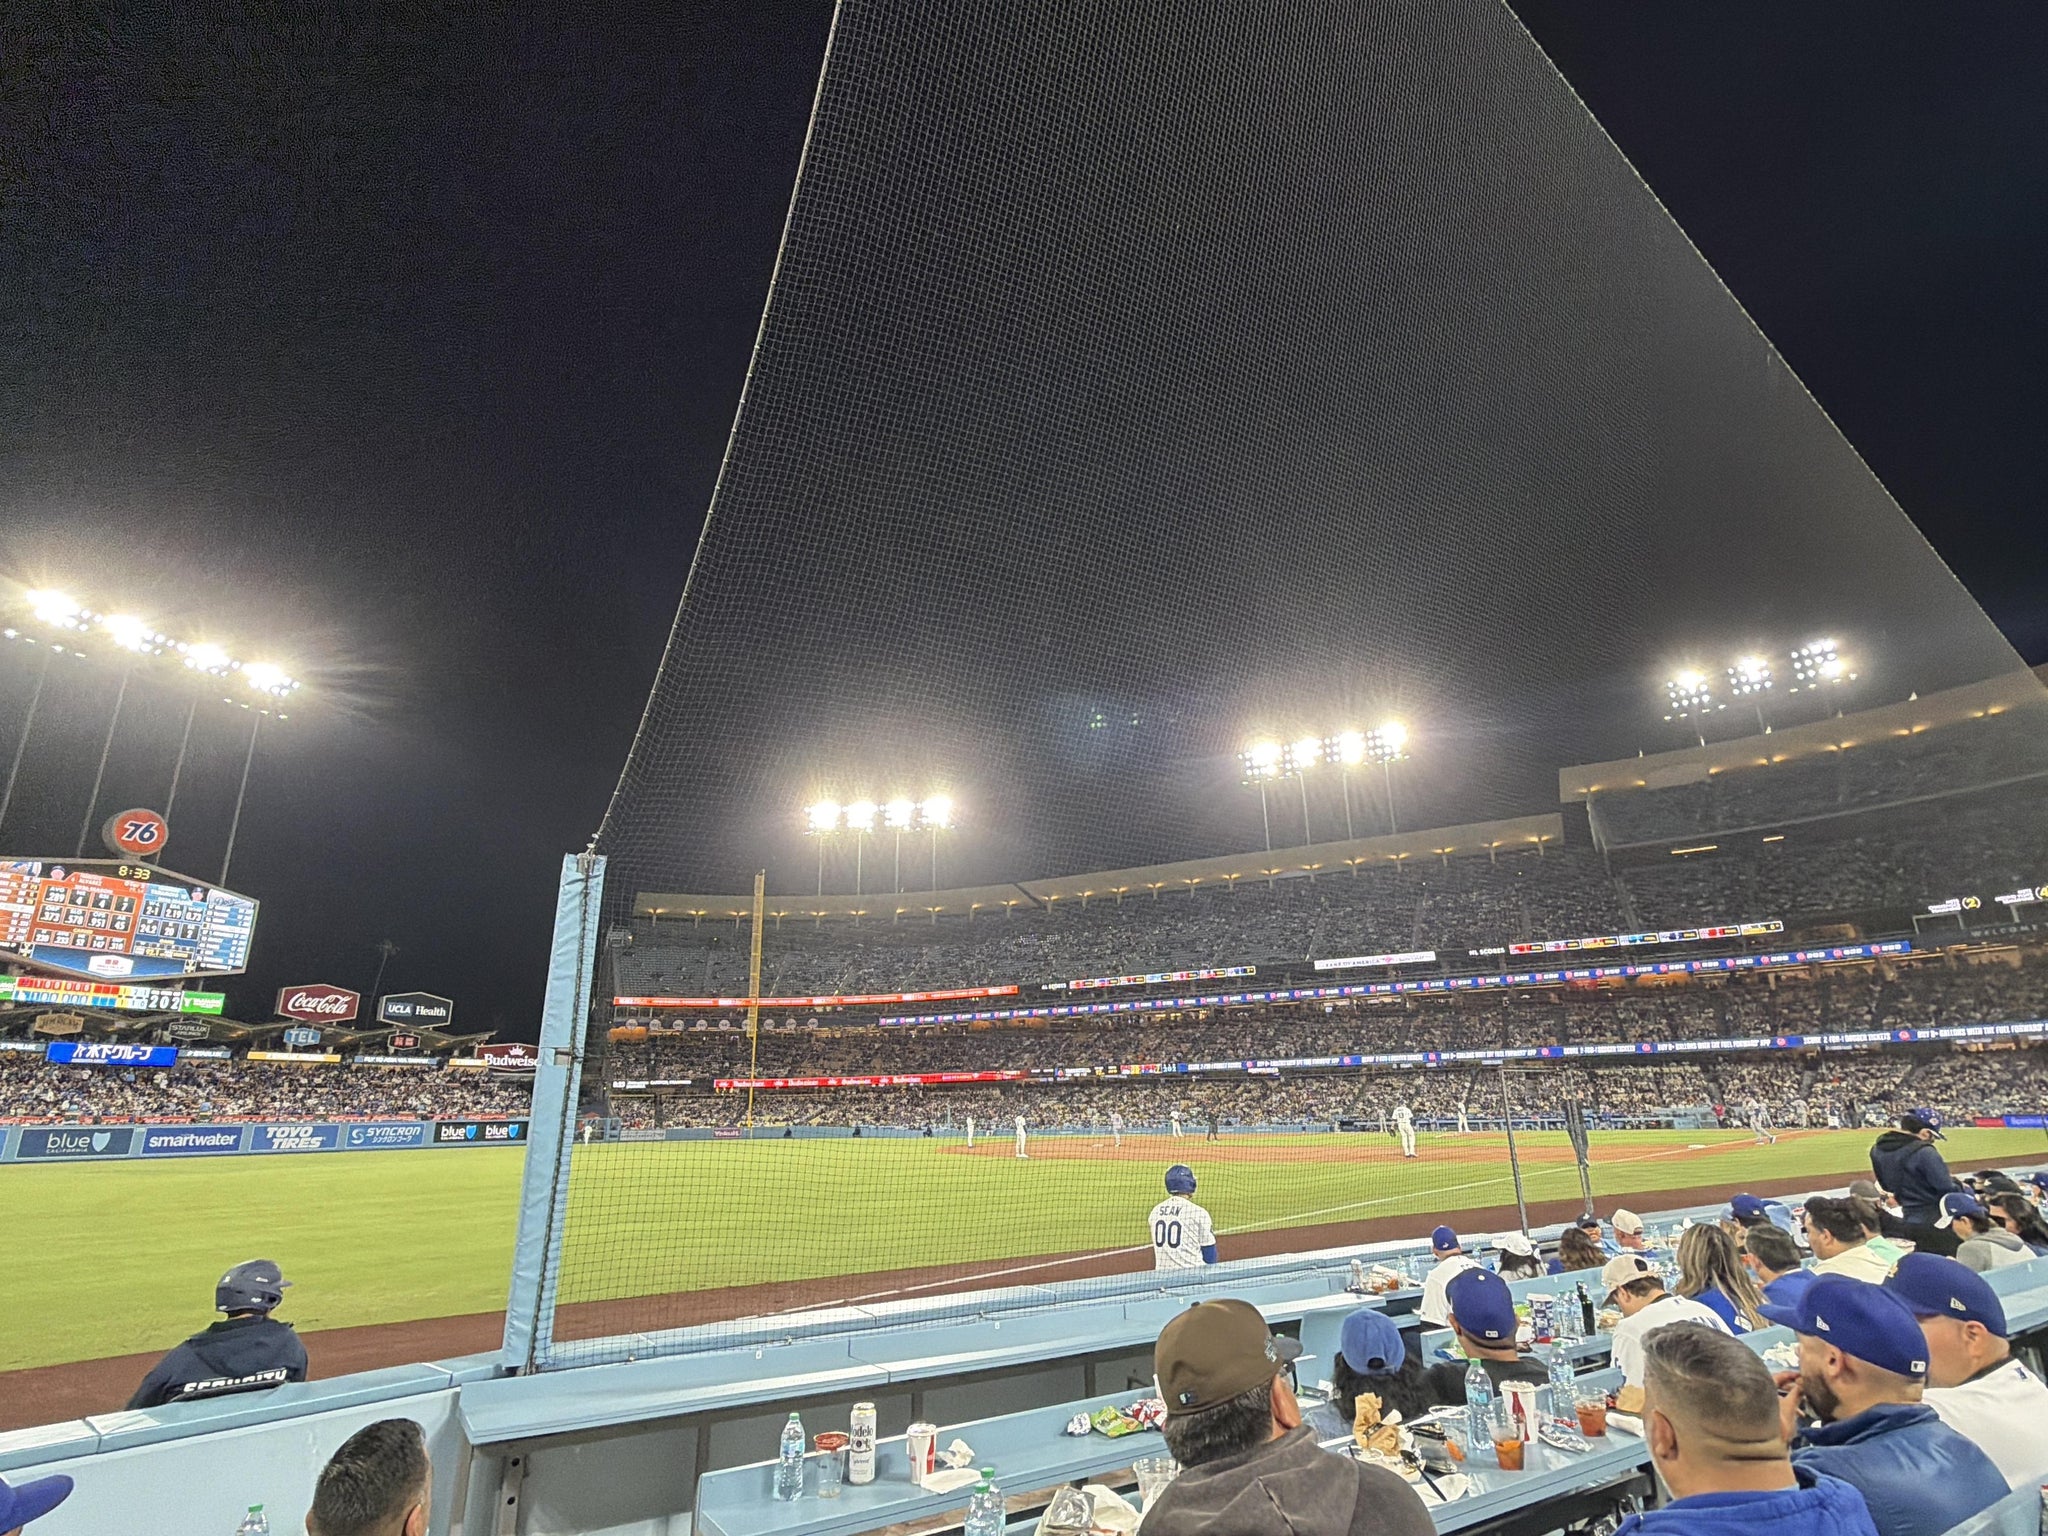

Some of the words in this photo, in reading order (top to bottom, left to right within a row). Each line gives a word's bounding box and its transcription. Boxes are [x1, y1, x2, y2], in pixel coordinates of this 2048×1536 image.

[121, 820, 159, 845] 76
[118, 865, 151, 880] 8:33
[76, 897, 82, 905] 4
[99, 900, 105, 908] 4
[121, 903, 128, 911] 7
[165, 909, 182, 918] 2.19
[185, 912, 201, 921] 0.73
[115, 922, 125, 930] 45
[140, 924, 157, 934] 24.2
[164, 928, 174, 936] 20
[187, 930, 193, 938] 2
[1971, 924, 2038, 937] WELCOME
[1480, 947, 1505, 955] SCORES
[148, 995, 159, 1008] 2
[160, 996, 170, 1009] 0
[171, 997, 180, 1010] 2
[288, 992, 352, 1014] Coca-Cola
[388, 1004, 411, 1014] UCLA
[415, 1005, 446, 1017] Health
[290, 1031, 315, 1042] TEL
[87, 1044, 153, 1060] 木下グループ
[484, 1053, 540, 1067] Budweise
[266, 1126, 313, 1138] TOYO
[441, 1125, 465, 1137] blue
[486, 1124, 508, 1135] blue
[47, 1133, 89, 1148] blue
[149, 1132, 236, 1148] smartwater
[272, 1137, 323, 1148] TIRES
[1159, 1205, 1182, 1217] SEAN
[1155, 1220, 1182, 1248] 00
